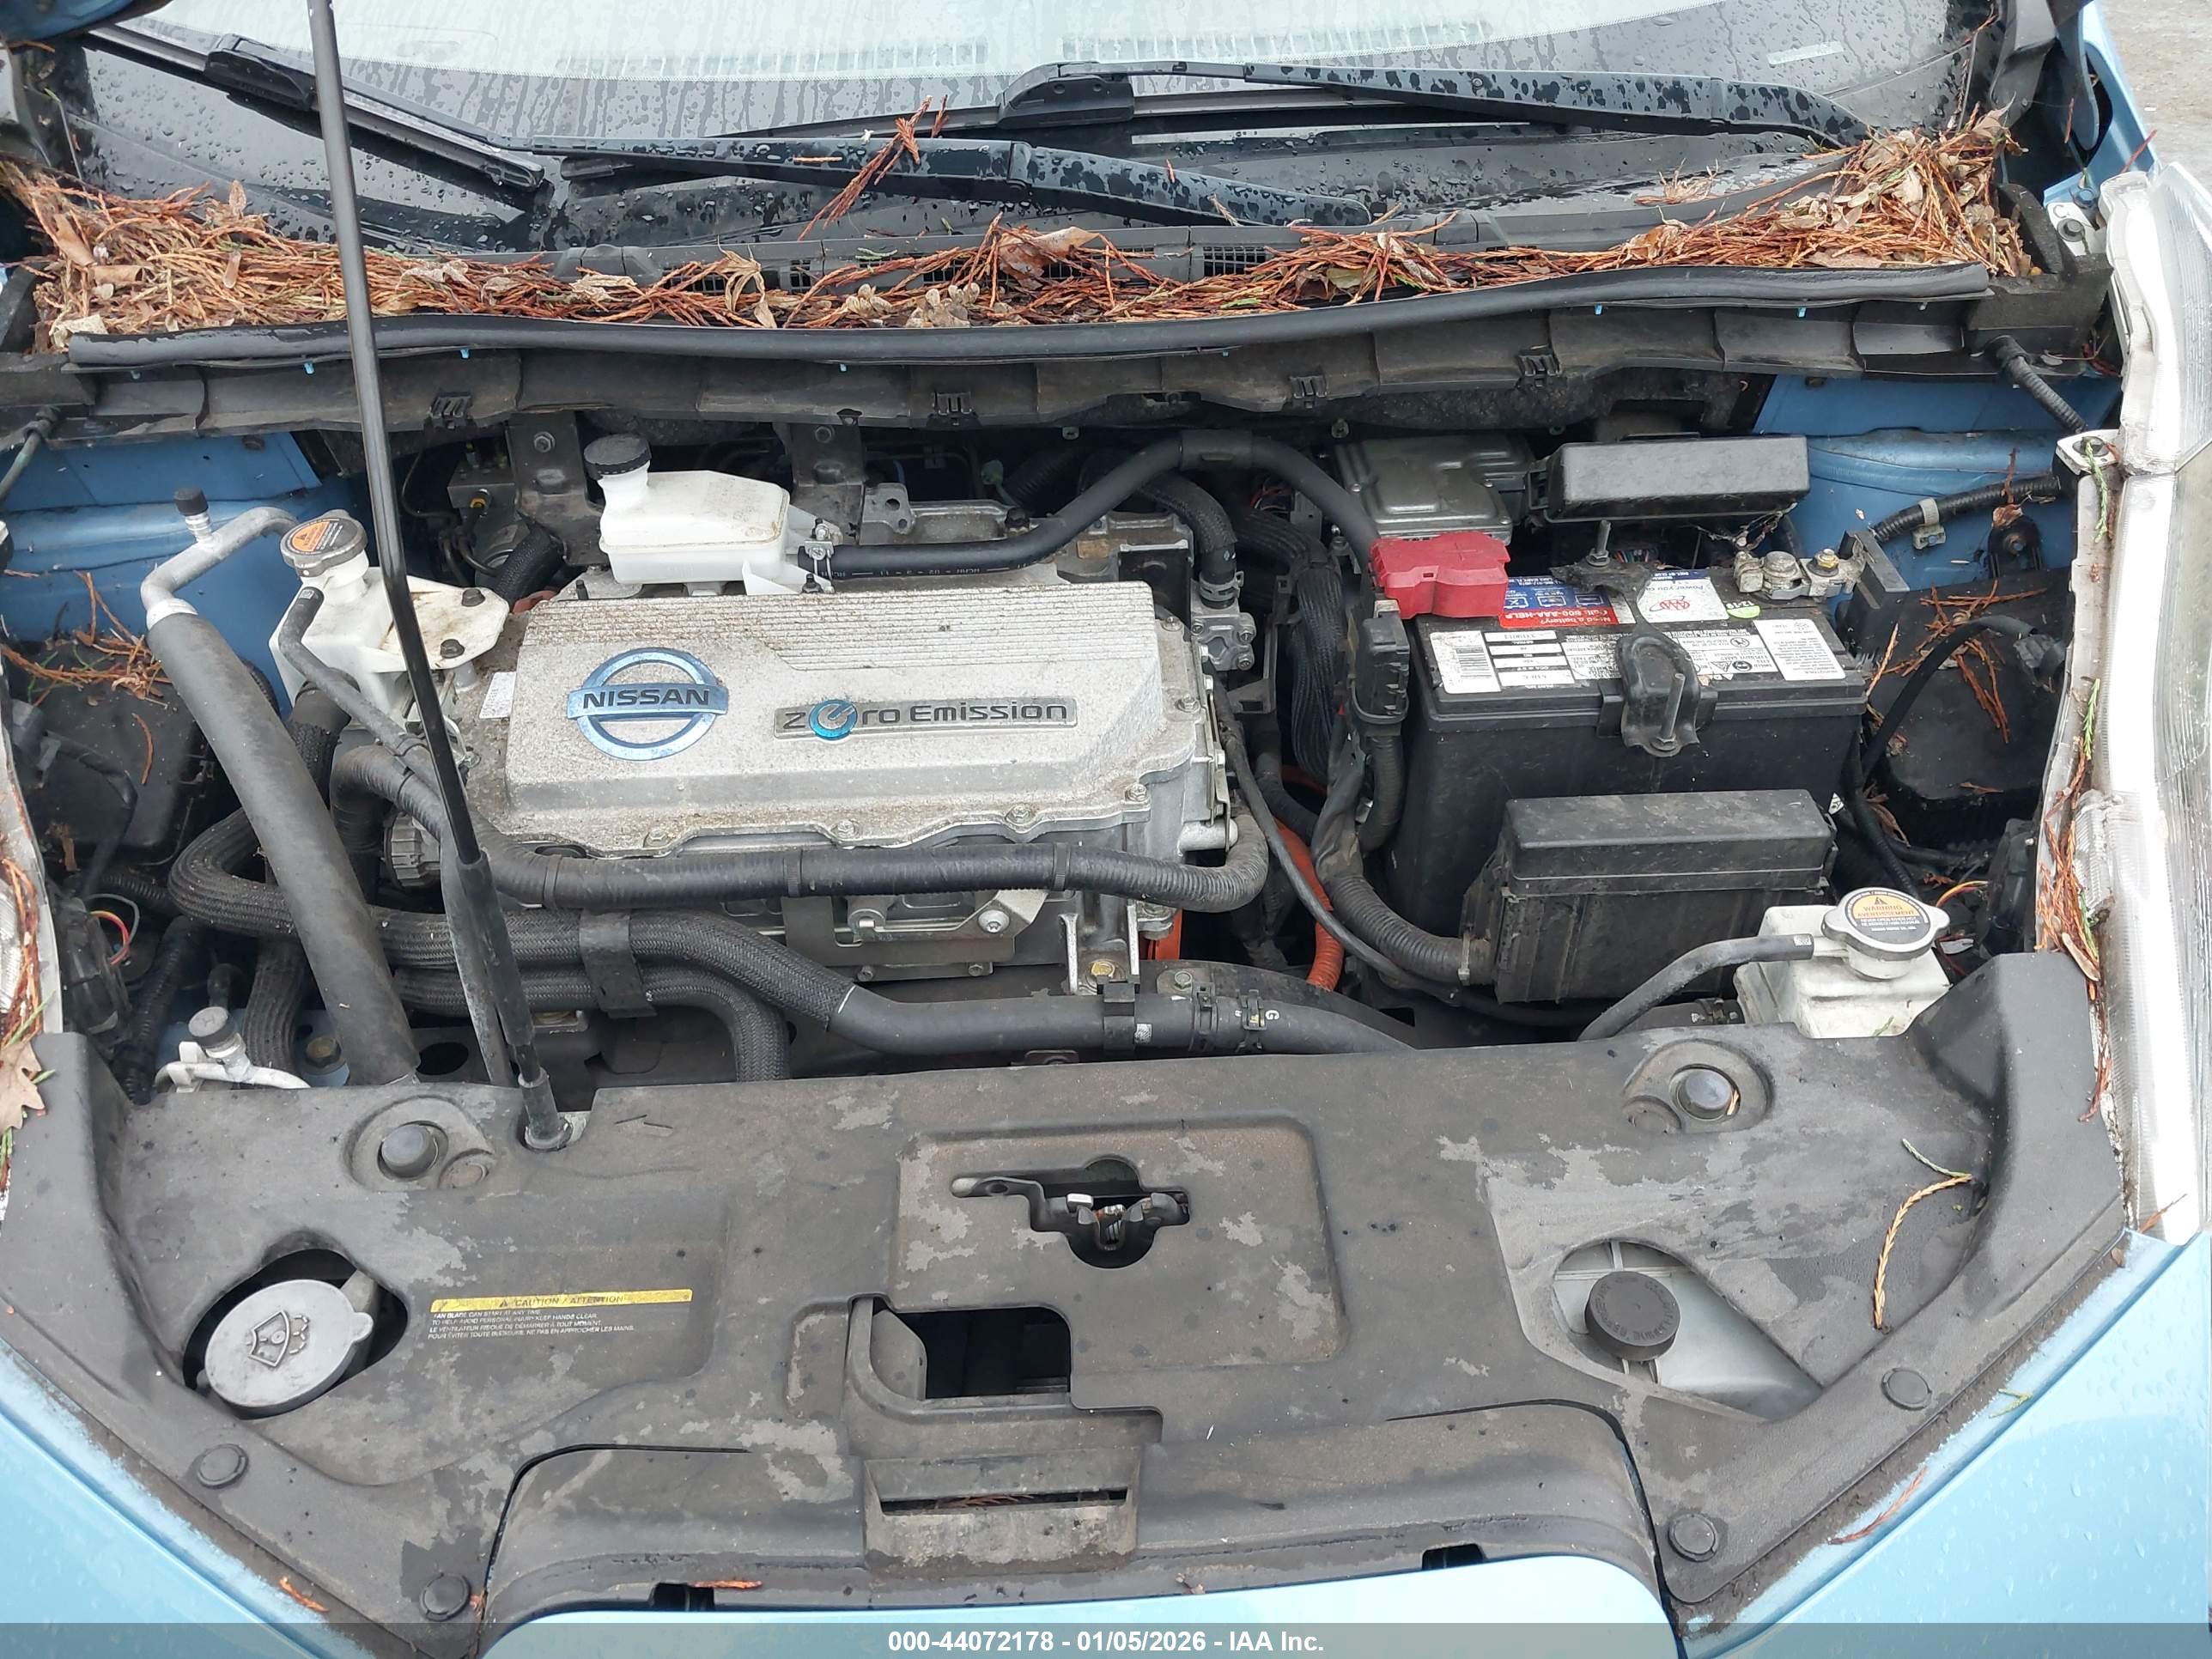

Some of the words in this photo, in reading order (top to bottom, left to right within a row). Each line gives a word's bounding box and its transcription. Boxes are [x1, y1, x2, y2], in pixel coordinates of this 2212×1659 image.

[1659, 599, 1687, 611] AAA
[1504, 610, 1582, 619] 800-AAA-HELP
[582, 686, 711, 709] NISSAN
[910, 701, 1067, 722] Emission
[514, 1298, 559, 1307] CAUTION
[570, 1296, 625, 1304] ATTENTION
